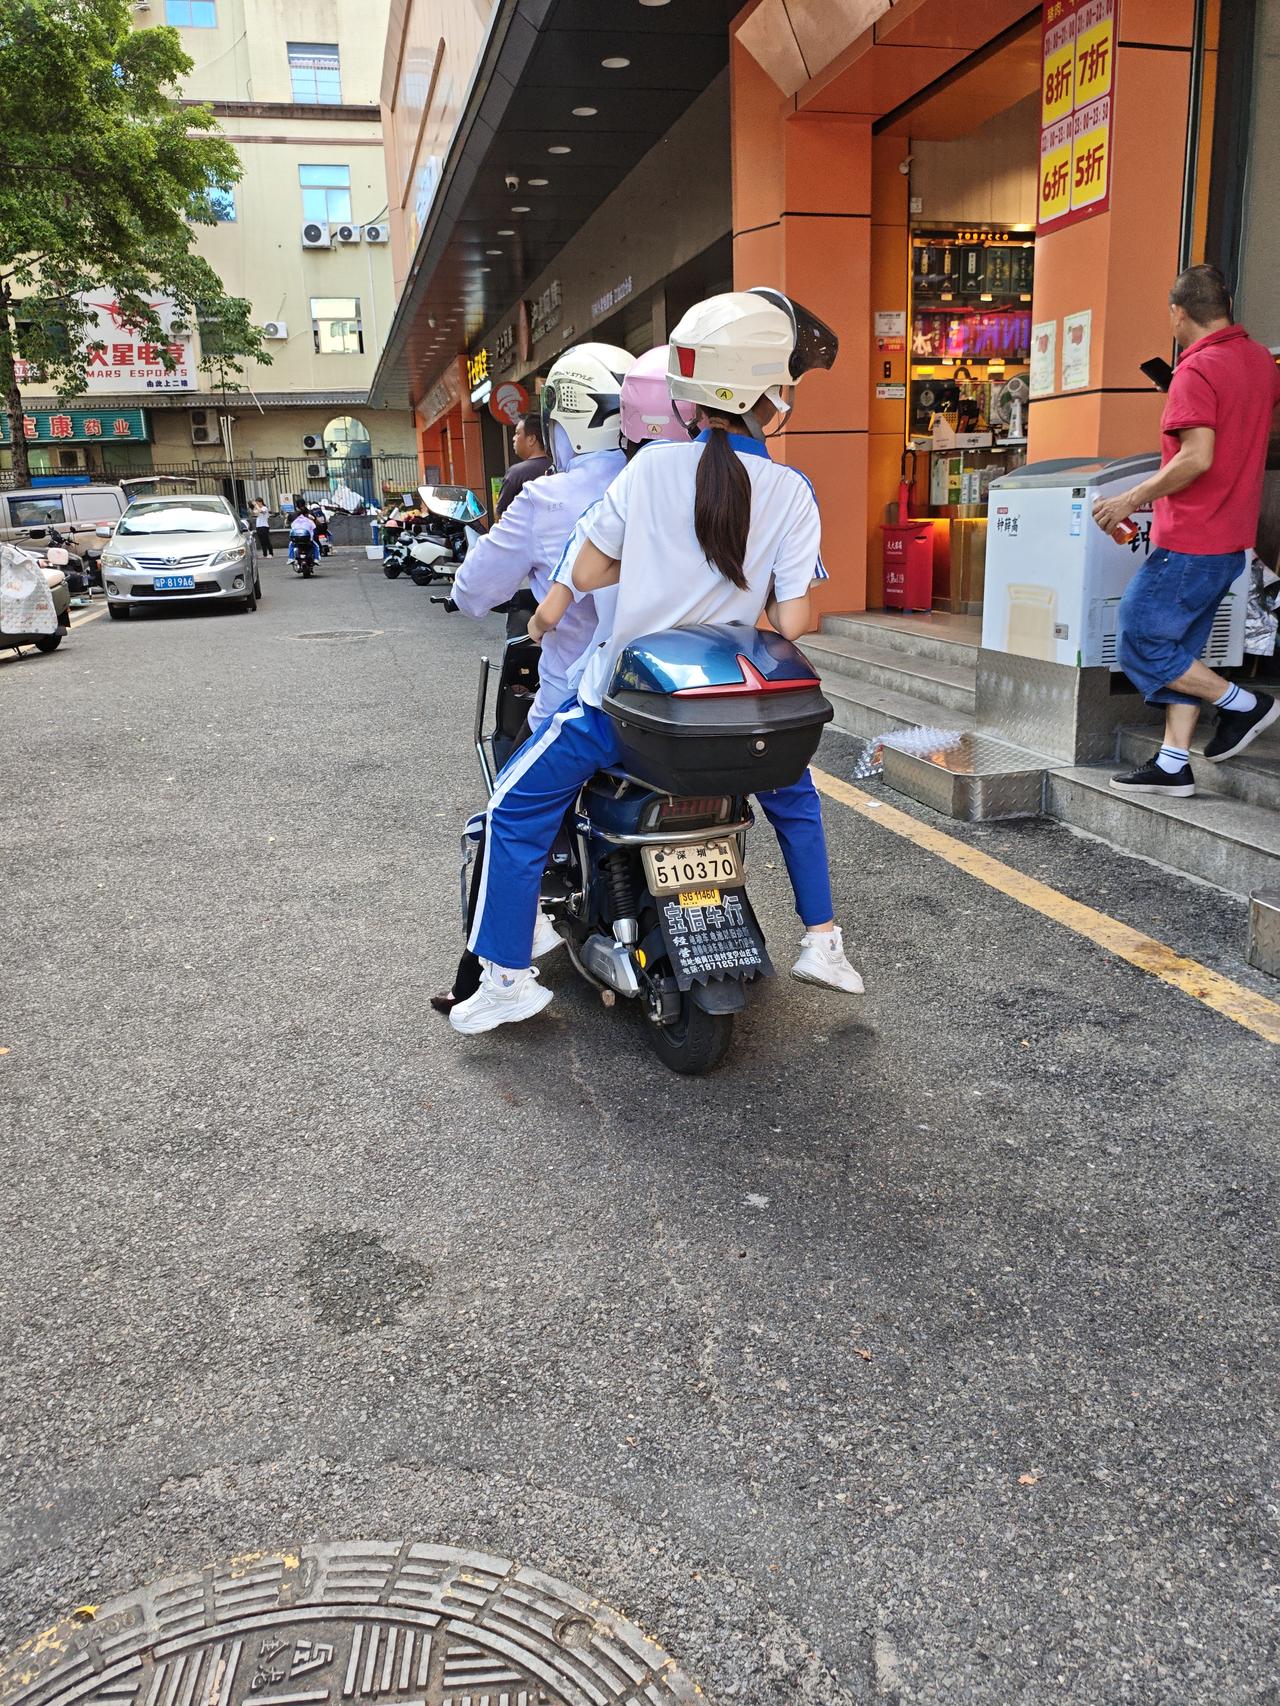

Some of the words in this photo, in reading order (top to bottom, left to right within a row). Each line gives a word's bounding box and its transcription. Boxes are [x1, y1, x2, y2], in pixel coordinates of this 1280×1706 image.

[1079, 36, 1109, 87] 7折
[1046, 59, 1072, 106] 8折
[1075, 143, 1105, 188] 5折
[1043, 160, 1069, 202] 6折
[957, 232, 1009, 241] TOBACCO
[86, 370, 121, 378] MARS
[130, 369, 188, 378] ESPORTS
[146, 380, 188, 388] 由此上二楼
[720, 390, 728, 399] A
[657, 859, 733, 884] 510370
